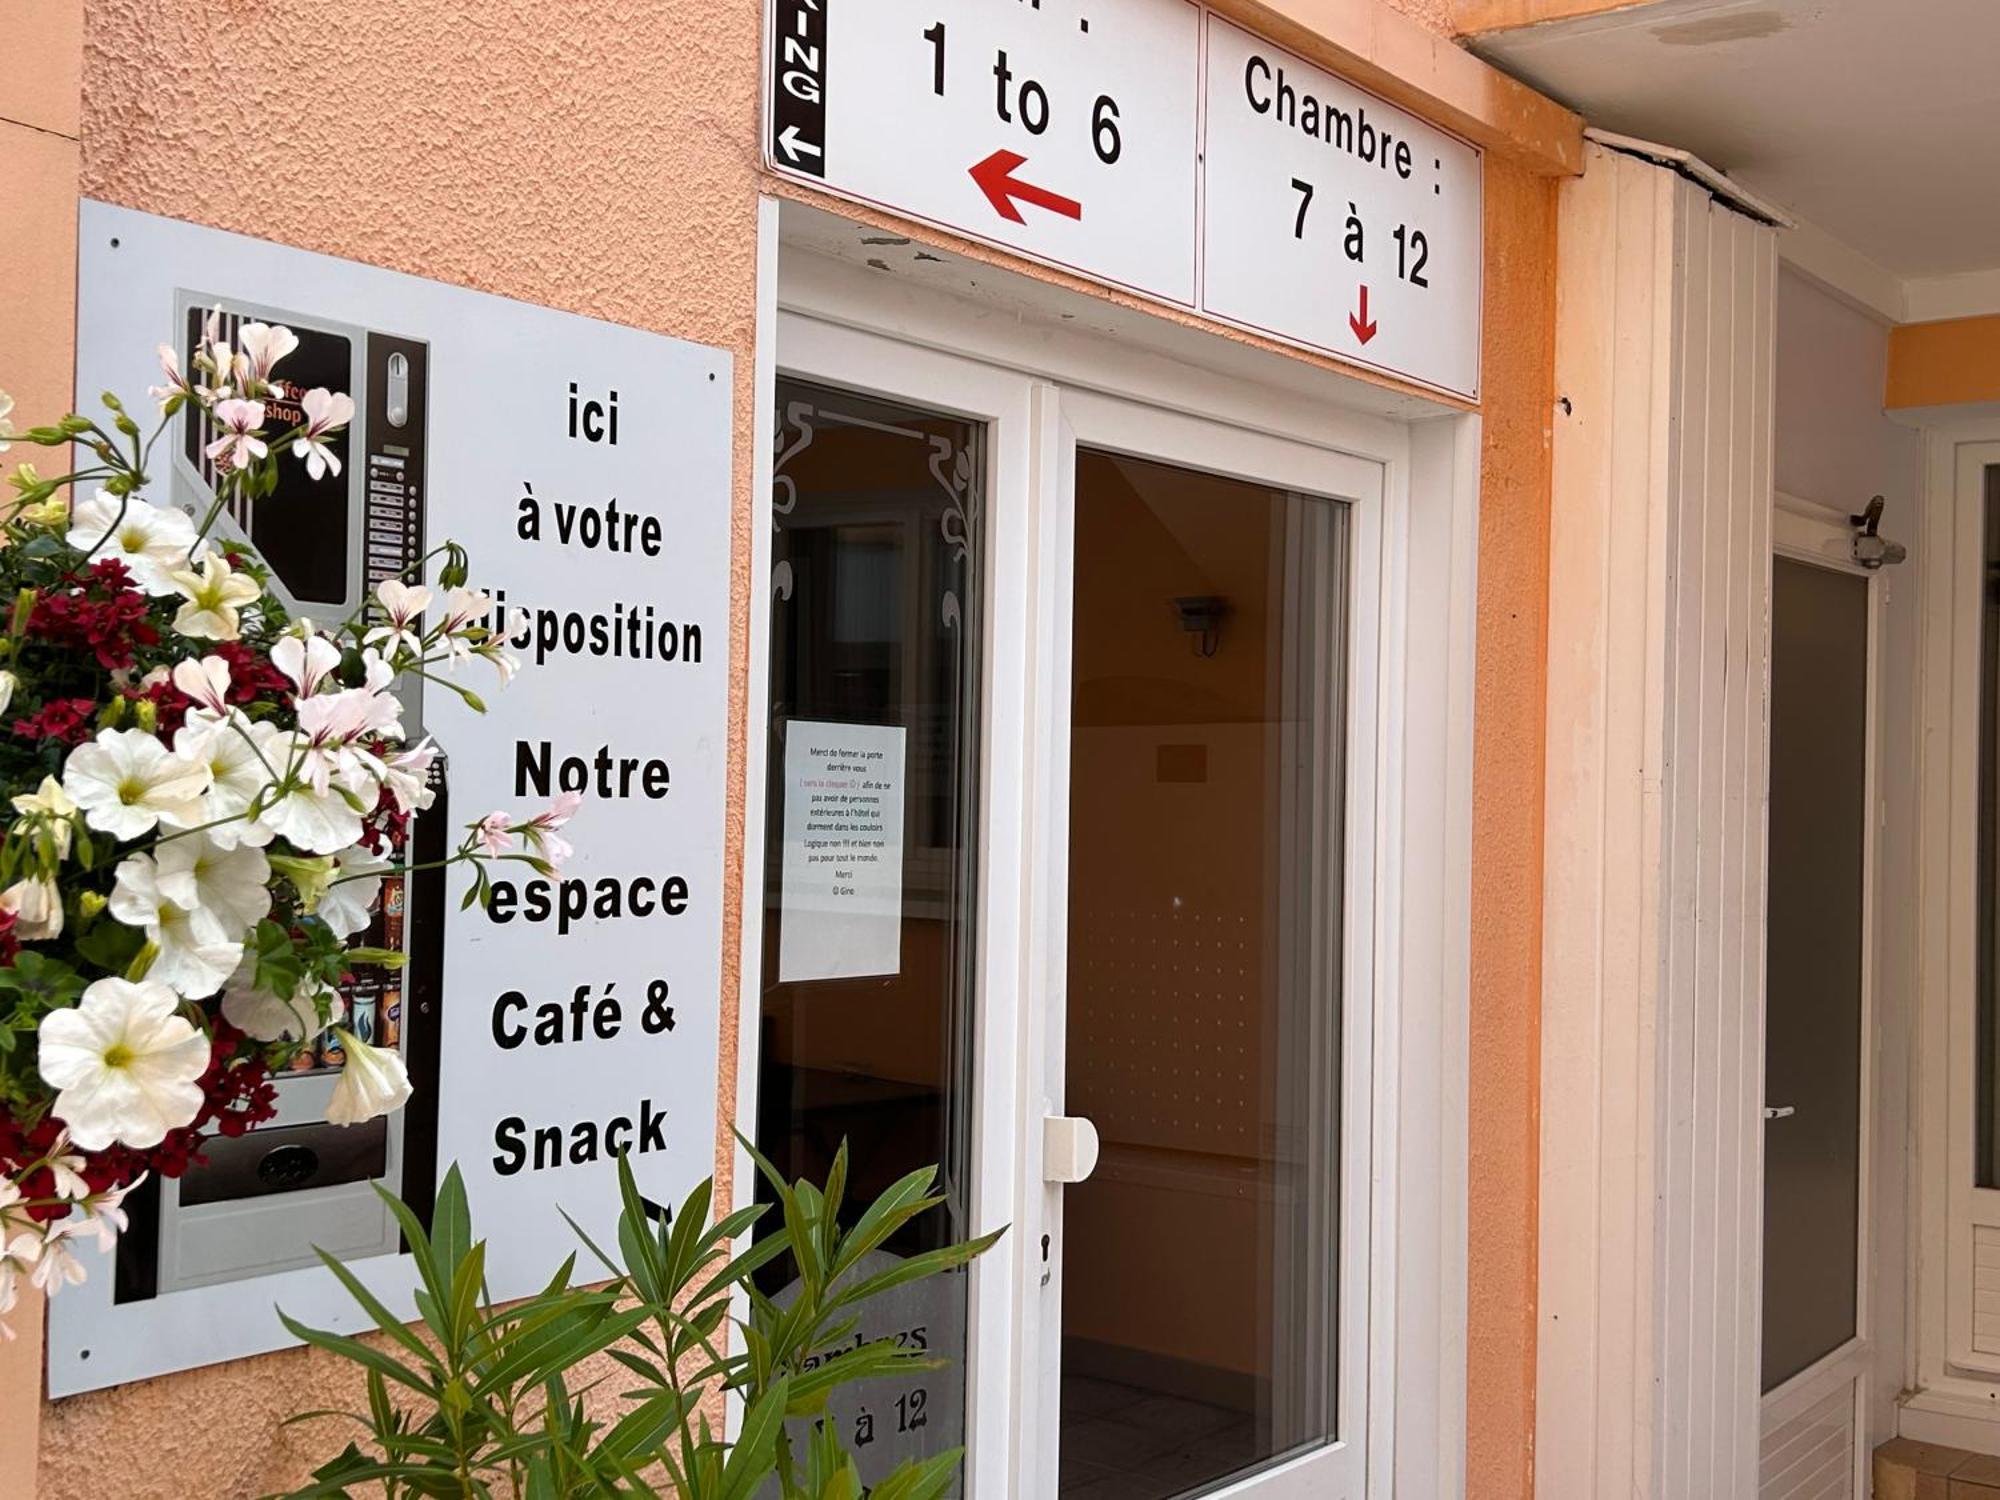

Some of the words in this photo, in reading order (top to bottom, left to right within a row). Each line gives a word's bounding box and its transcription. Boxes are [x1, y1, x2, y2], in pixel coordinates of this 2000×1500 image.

[782, 0, 820, 104] ING
[923, 22, 945, 96] 1
[993, 49, 1050, 136] to
[1091, 95, 1122, 165] 6
[1245, 55, 1412, 179] Chambre
[1291, 177, 1314, 240] 7
[1343, 201, 1364, 263] à
[1392, 223, 1428, 288] 12
[265, 403, 301, 426] shop
[568, 382, 619, 446] ici
[516, 481, 541, 541] à
[554, 498, 662, 557] votre
[515, 740, 670, 799] Notre
[810, 747, 829, 757] Merci
[829, 748, 837, 757] de
[838, 748, 859, 758] fermer
[867, 751, 884, 760] porte
[840, 795, 848, 803] de
[849, 796, 879, 804] personnes
[862, 781, 874, 789] afin
[875, 782, 882, 790] de
[804, 839, 828, 849] Logique
[807, 823, 833, 831] dorment
[834, 823, 849, 831] dans
[850, 823, 858, 831] les
[859, 824, 884, 832] couloirs
[820, 856, 835, 864] pour
[835, 871, 853, 879] Merci
[487, 876, 689, 935] espace
[492, 983, 622, 1049] Café
[641, 979, 676, 1035] &
[492, 1099, 667, 1176] Snack
[854, 1406, 874, 1448] à
[894, 1388, 928, 1433] 12
